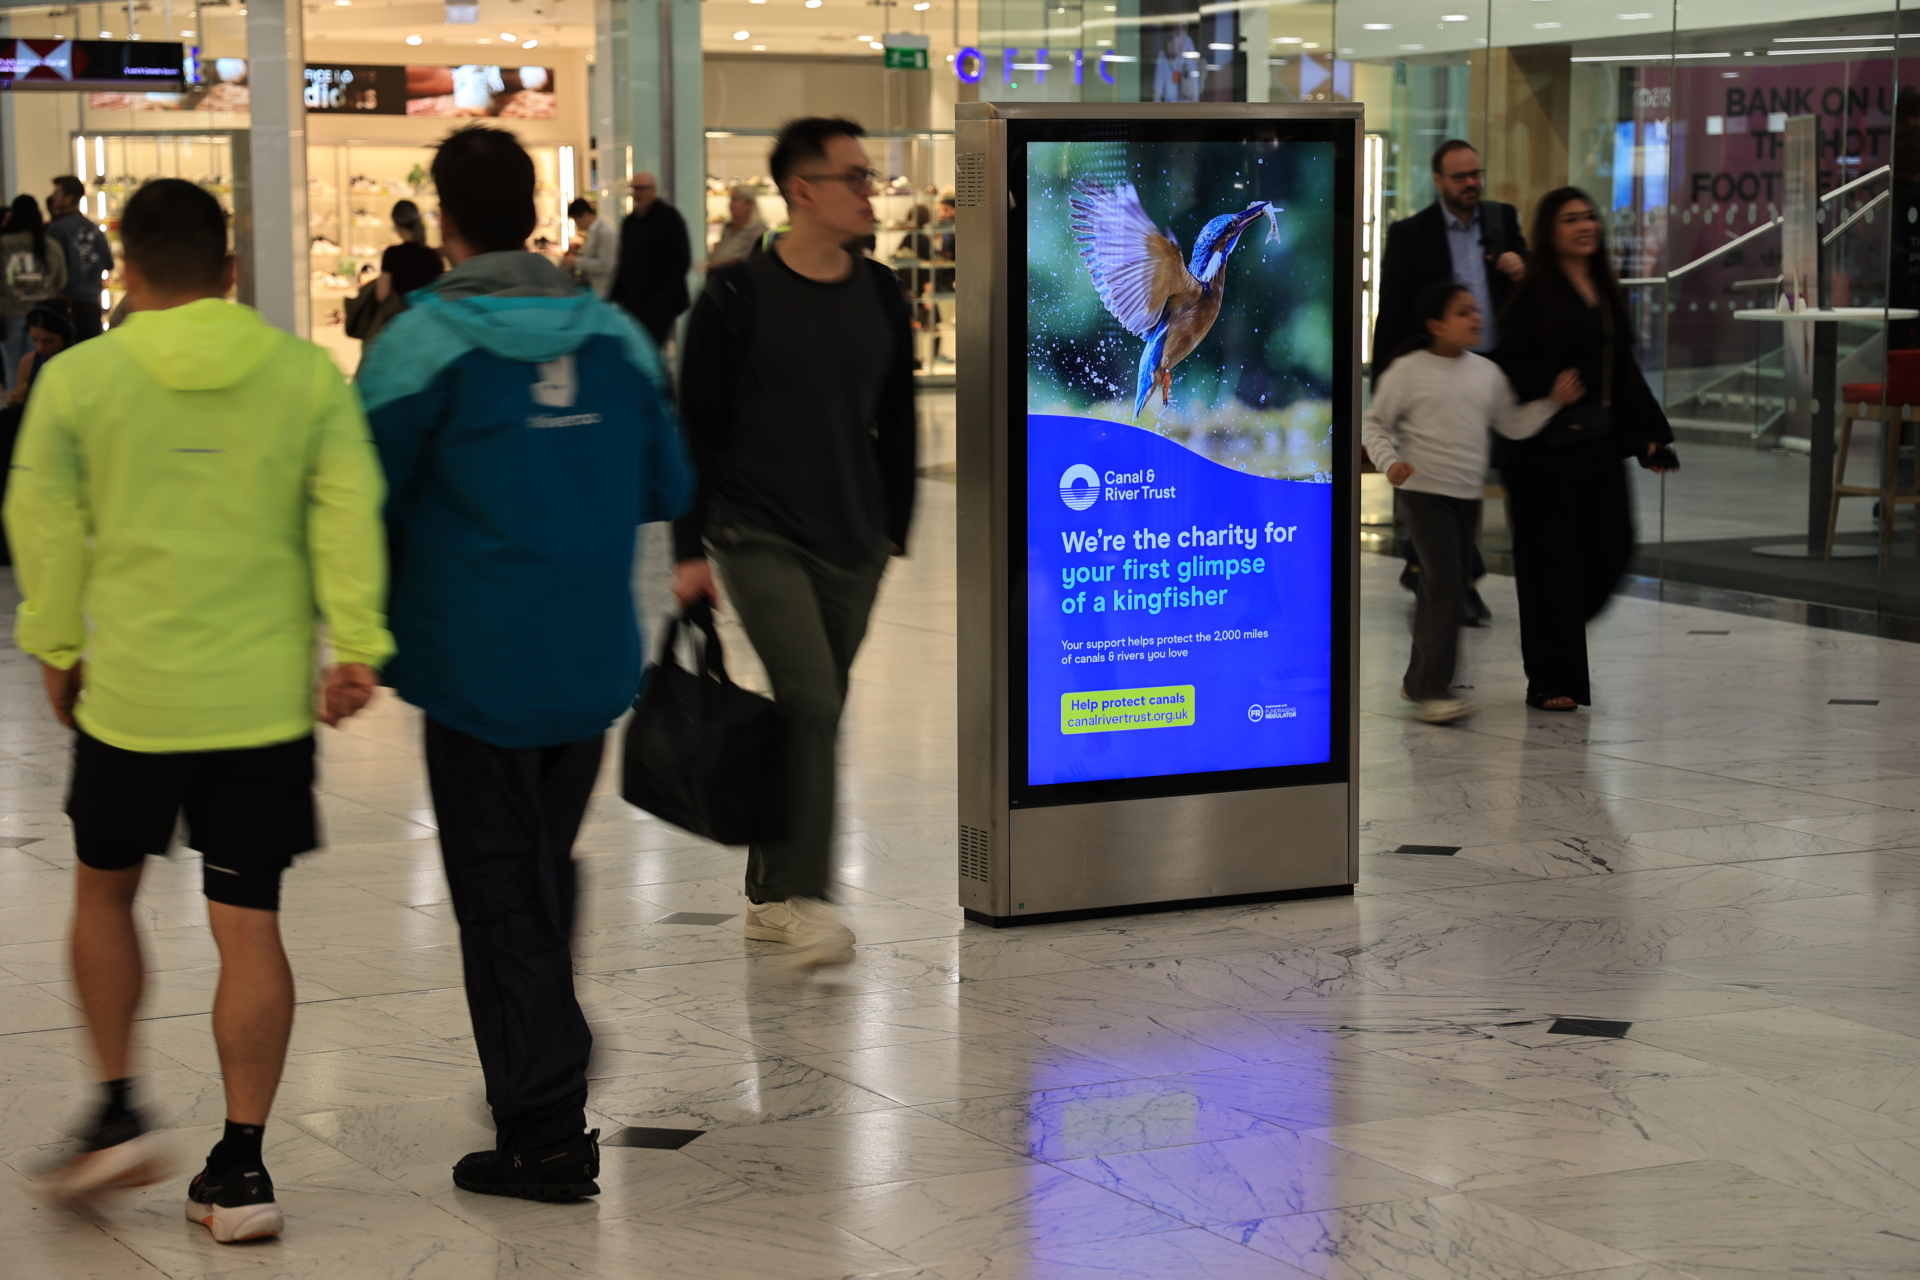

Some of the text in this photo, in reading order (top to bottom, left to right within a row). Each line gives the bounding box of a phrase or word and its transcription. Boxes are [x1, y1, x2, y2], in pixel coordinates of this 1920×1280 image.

[1727, 87, 1814, 117] BANK
[1821, 86, 1870, 116] ON
[1691, 171, 1877, 202] FOOTEAR
[1104, 468, 1156, 485] Canal &
[1105, 485, 1177, 501] River Trust
[1061, 521, 1298, 553] We’re the charity for
[1062, 554, 1266, 590] your first glimpse
[1061, 585, 1229, 615] of a kingfisher
[1061, 628, 1269, 651] Your support helps protect the 2,000 miles
[1061, 648, 1189, 665] of canals & rivers you love
[1071, 692, 1186, 712] Help protect canals
[1067, 708, 1189, 728] canalrivertrust.org.uk
[1250, 709, 1261, 718] FR
[1265, 711, 1297, 719] REGULATOR
